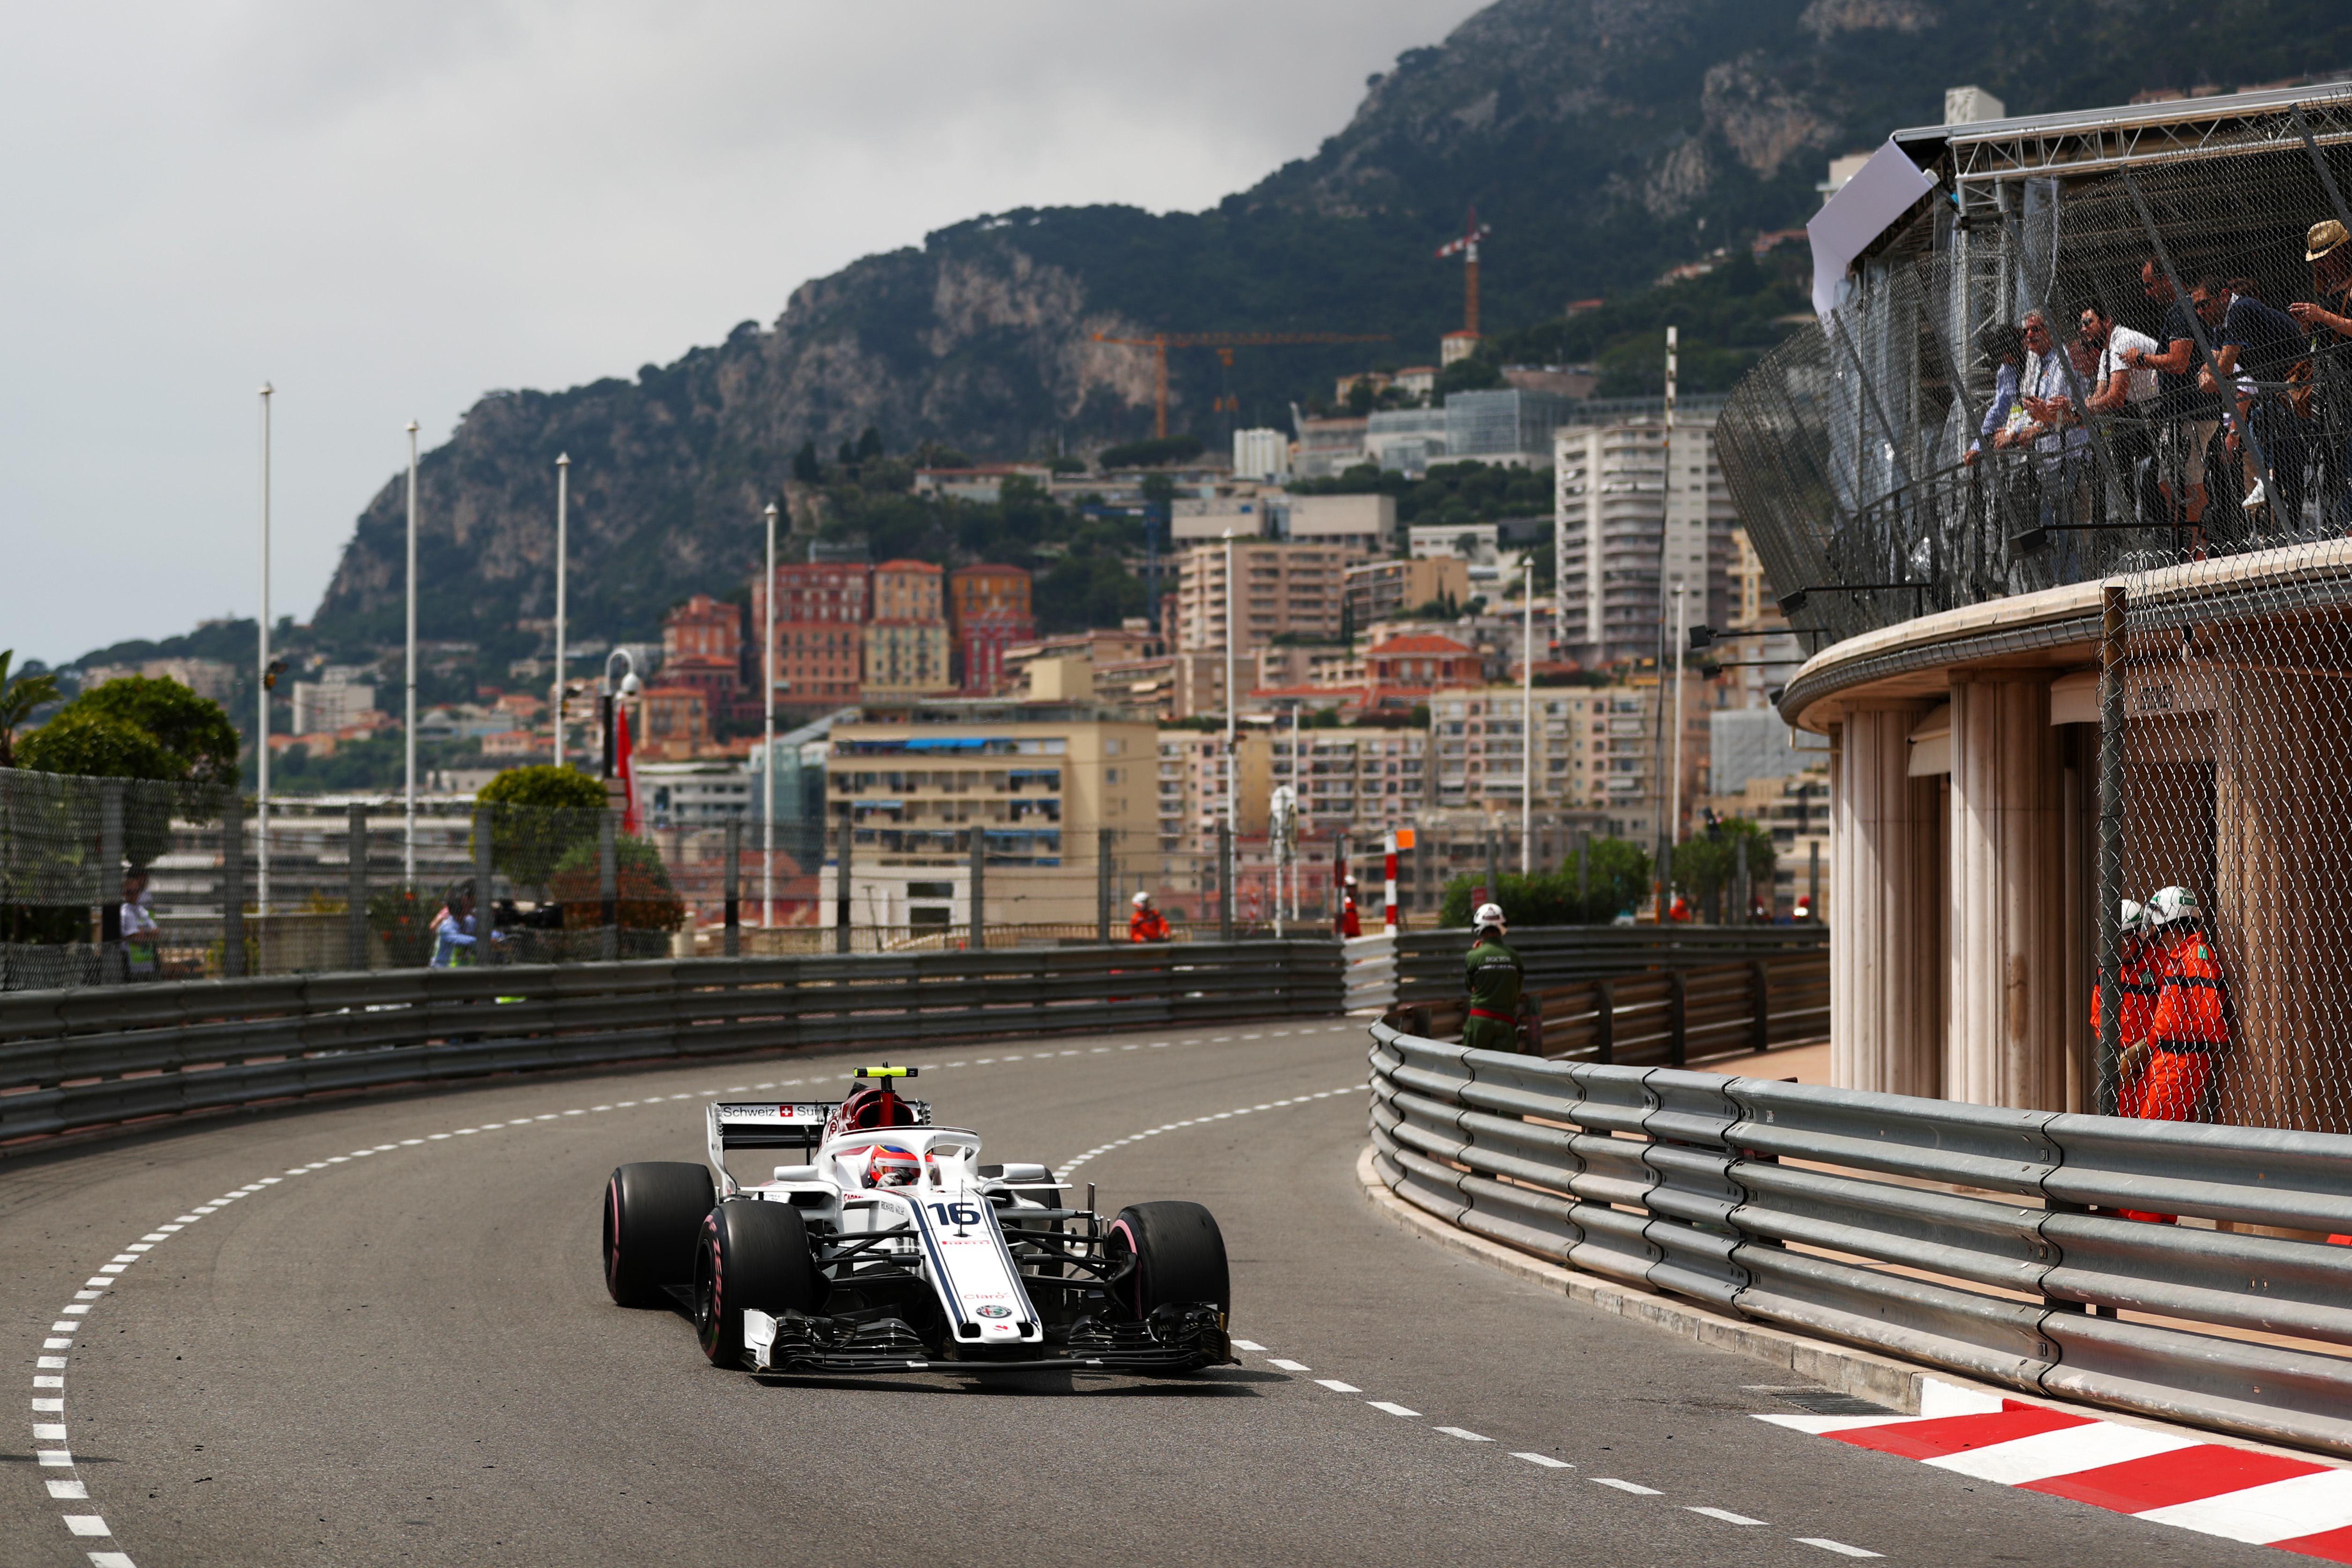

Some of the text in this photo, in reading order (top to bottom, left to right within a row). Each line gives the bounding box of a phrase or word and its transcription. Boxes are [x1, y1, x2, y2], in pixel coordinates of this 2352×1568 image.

[723, 1106, 837, 1117] Schweiz Suise
[927, 1202, 981, 1225] 16
[713, 1237, 722, 1319] ZERO
